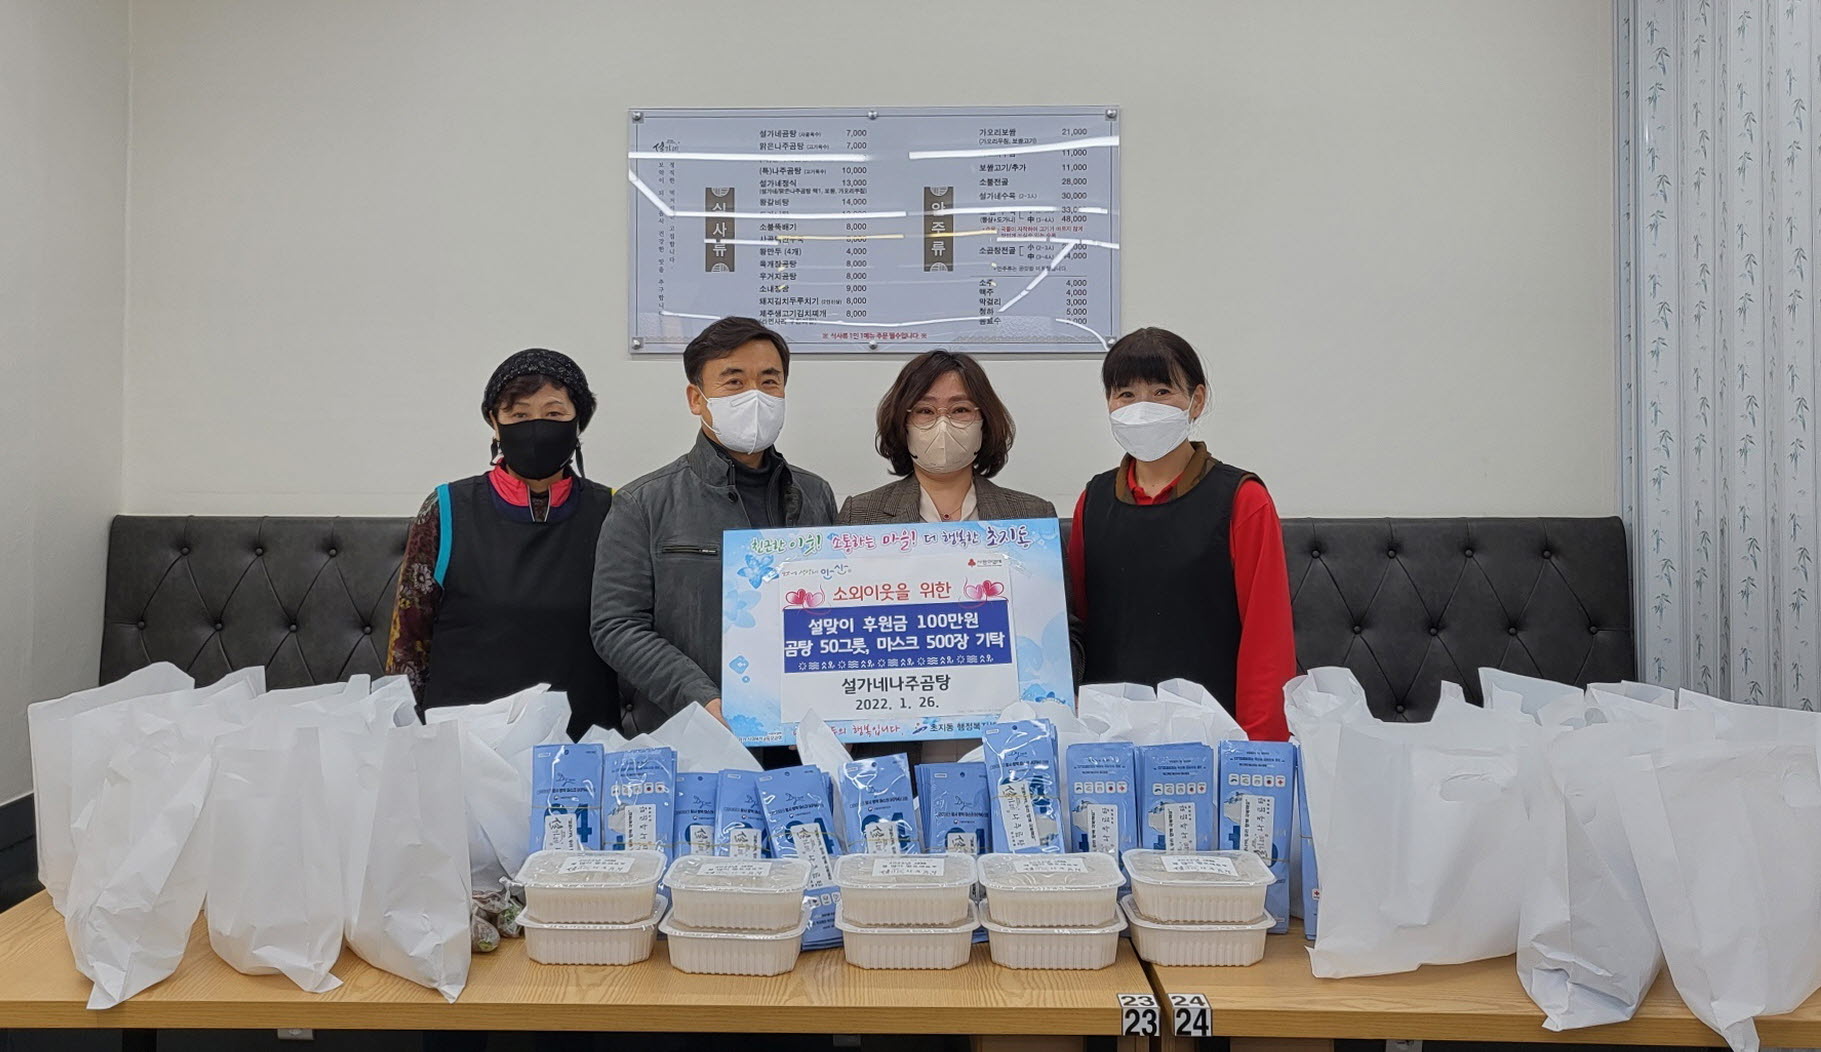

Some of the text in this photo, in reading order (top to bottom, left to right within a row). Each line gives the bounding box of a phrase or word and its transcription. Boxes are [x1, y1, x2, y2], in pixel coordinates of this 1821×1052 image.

[759, 129, 797, 138] 설가네곰탕
[846, 129, 868, 137] 7,000
[979, 128, 1088, 137] 가오리보쌈 21,000
[759, 142, 804, 151] 맑은나주곰탕
[846, 142, 868, 150] 7,000
[1062, 149, 1088, 157] 11,000
[842, 167, 868, 175] 10,000
[979, 163, 1088, 172] 보쌈고기/추가 11,000
[759, 179, 868, 187] 설가네정식 13,000
[979, 178, 1088, 186] 소불전골 28,000
[979, 192, 1016, 200] 설가네수육
[1061, 192, 1088, 200] 30,000
[759, 198, 868, 206] 왕갈비탕 14,000
[1061, 206, 1087, 214] 33,0
[1061, 215, 1088, 223] 48,000
[759, 223, 867, 231] 소불뚝배기 8,000
[759, 247, 867, 256] 왕만두 (4개) 4,000
[979, 246, 1016, 255] 소곱창전골
[846, 260, 867, 268] 8,000
[759, 272, 867, 280] 우거지곰탕 8,000
[1066, 279, 1088, 287] 4,000
[846, 285, 867, 293] 9,000
[1066, 288, 1088, 296] 4,000
[759, 297, 819, 305] 돼지김치두루치기
[846, 297, 867, 305] 8,000
[979, 298, 1088, 306] 막걸리 3,000
[759, 309, 867, 318] 제주생고기김치찌개 8,000
[979, 308, 1088, 316] 청하 5,000
[751, 526, 1032, 556] 친근한 이웃! 소통하는 마을! 더 행복한 초지동
[832, 580, 952, 602] 소외이웃을 위한
[808, 611, 980, 636] 설맞이 후원금 100만원
[784, 631, 1005, 657] 곰탕 50그릇, 마스크 500장 기탁
[841, 674, 951, 695] 설가네나주곰탕
[855, 696, 939, 711] 2022. 1. 26.
[852, 724, 904, 737] 행복입니다.
[930, 722, 954, 732] 초지동
[1121, 995, 1155, 1007] 23
[1171, 995, 1205, 1007] 24
[1124, 1008, 1158, 1036] 23
[1176, 1008, 1209, 1036] 24
